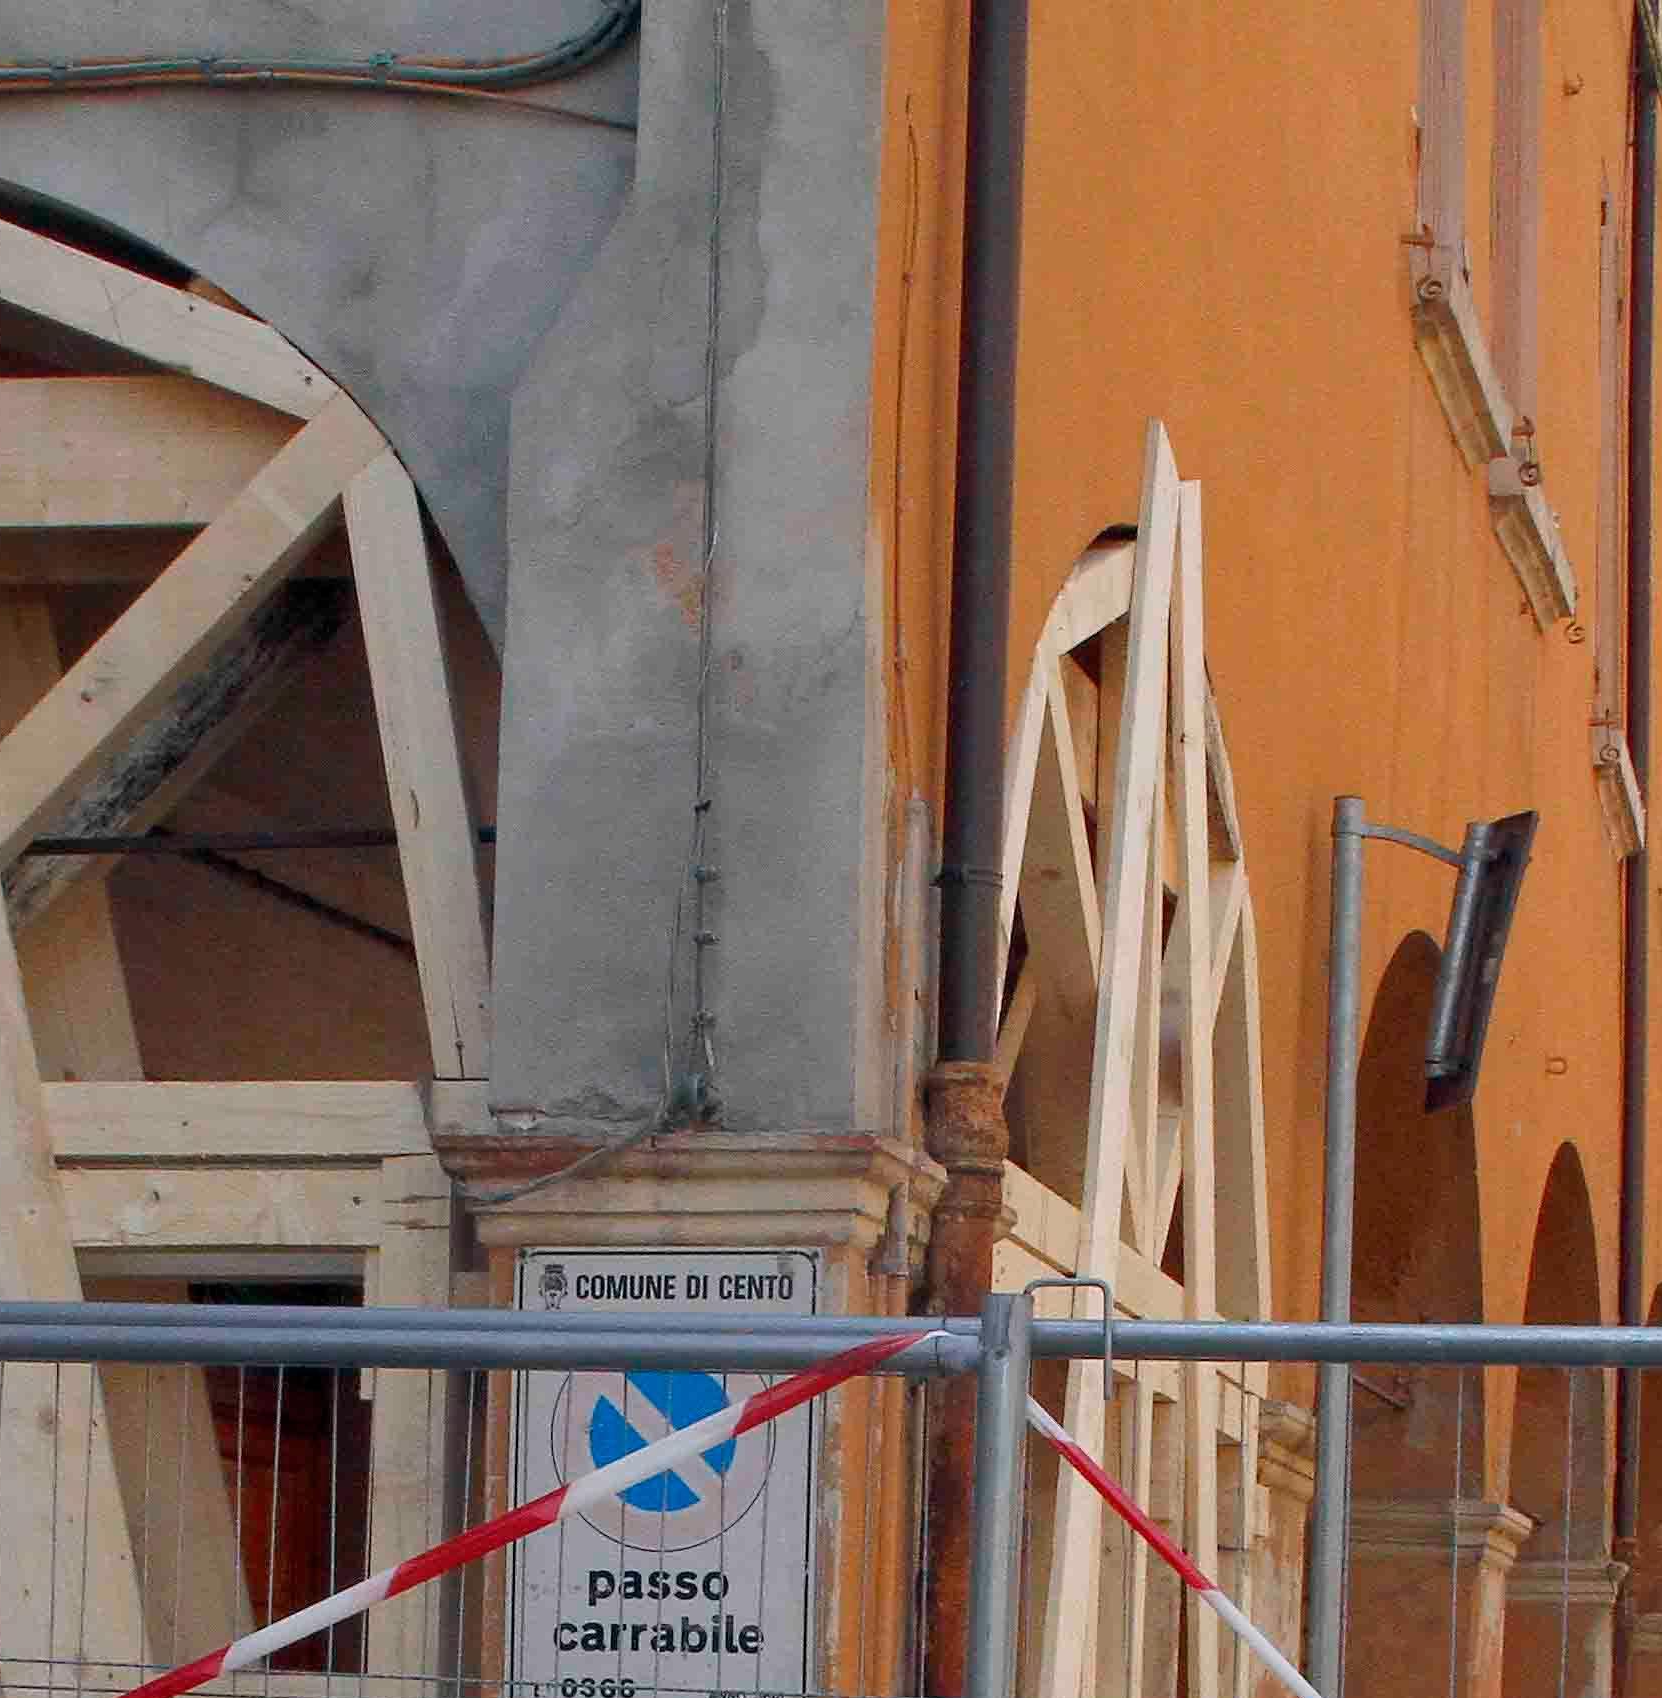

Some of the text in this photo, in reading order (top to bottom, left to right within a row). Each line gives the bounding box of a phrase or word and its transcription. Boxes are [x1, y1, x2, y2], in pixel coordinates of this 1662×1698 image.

[575, 1272, 794, 1302] COMUNE DI CENTO
[587, 1567, 729, 1607] passo
[552, 1614, 765, 1655] carrabile
